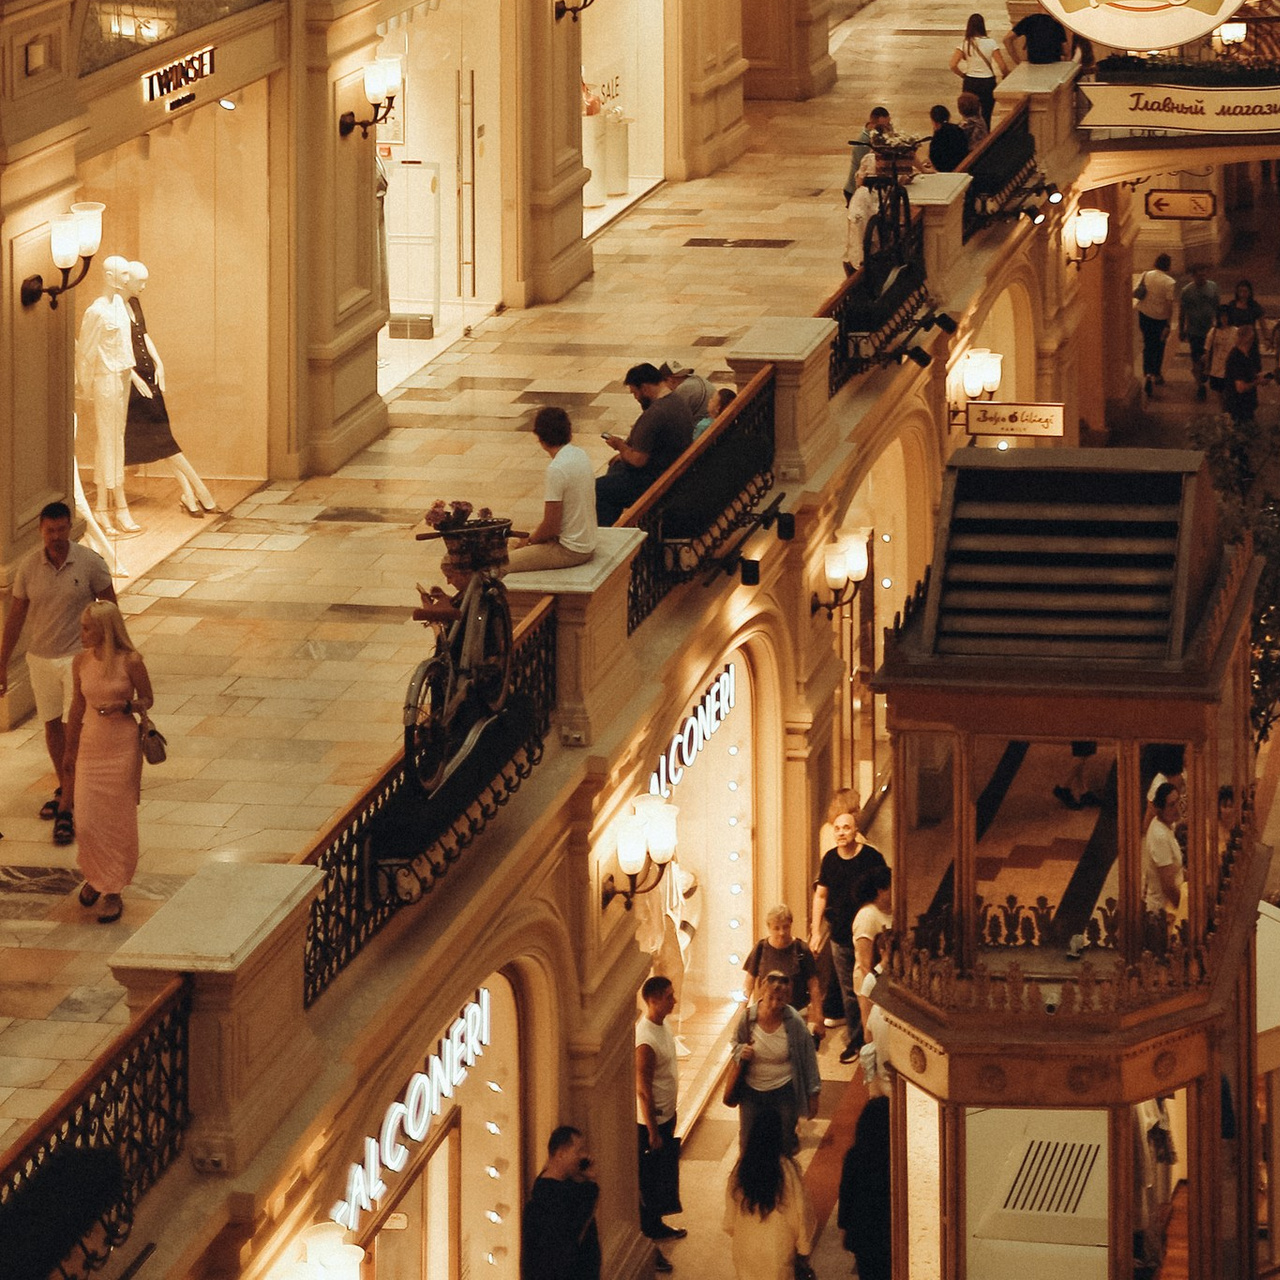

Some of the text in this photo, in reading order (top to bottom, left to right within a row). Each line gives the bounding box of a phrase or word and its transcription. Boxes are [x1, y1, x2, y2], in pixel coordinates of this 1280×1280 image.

[141, 45, 218, 102] TWINSET
[601, 75, 620, 106] SALE
[1128, 92, 1206, 116] Главный
[648, 662, 736, 799] ALCONERI
